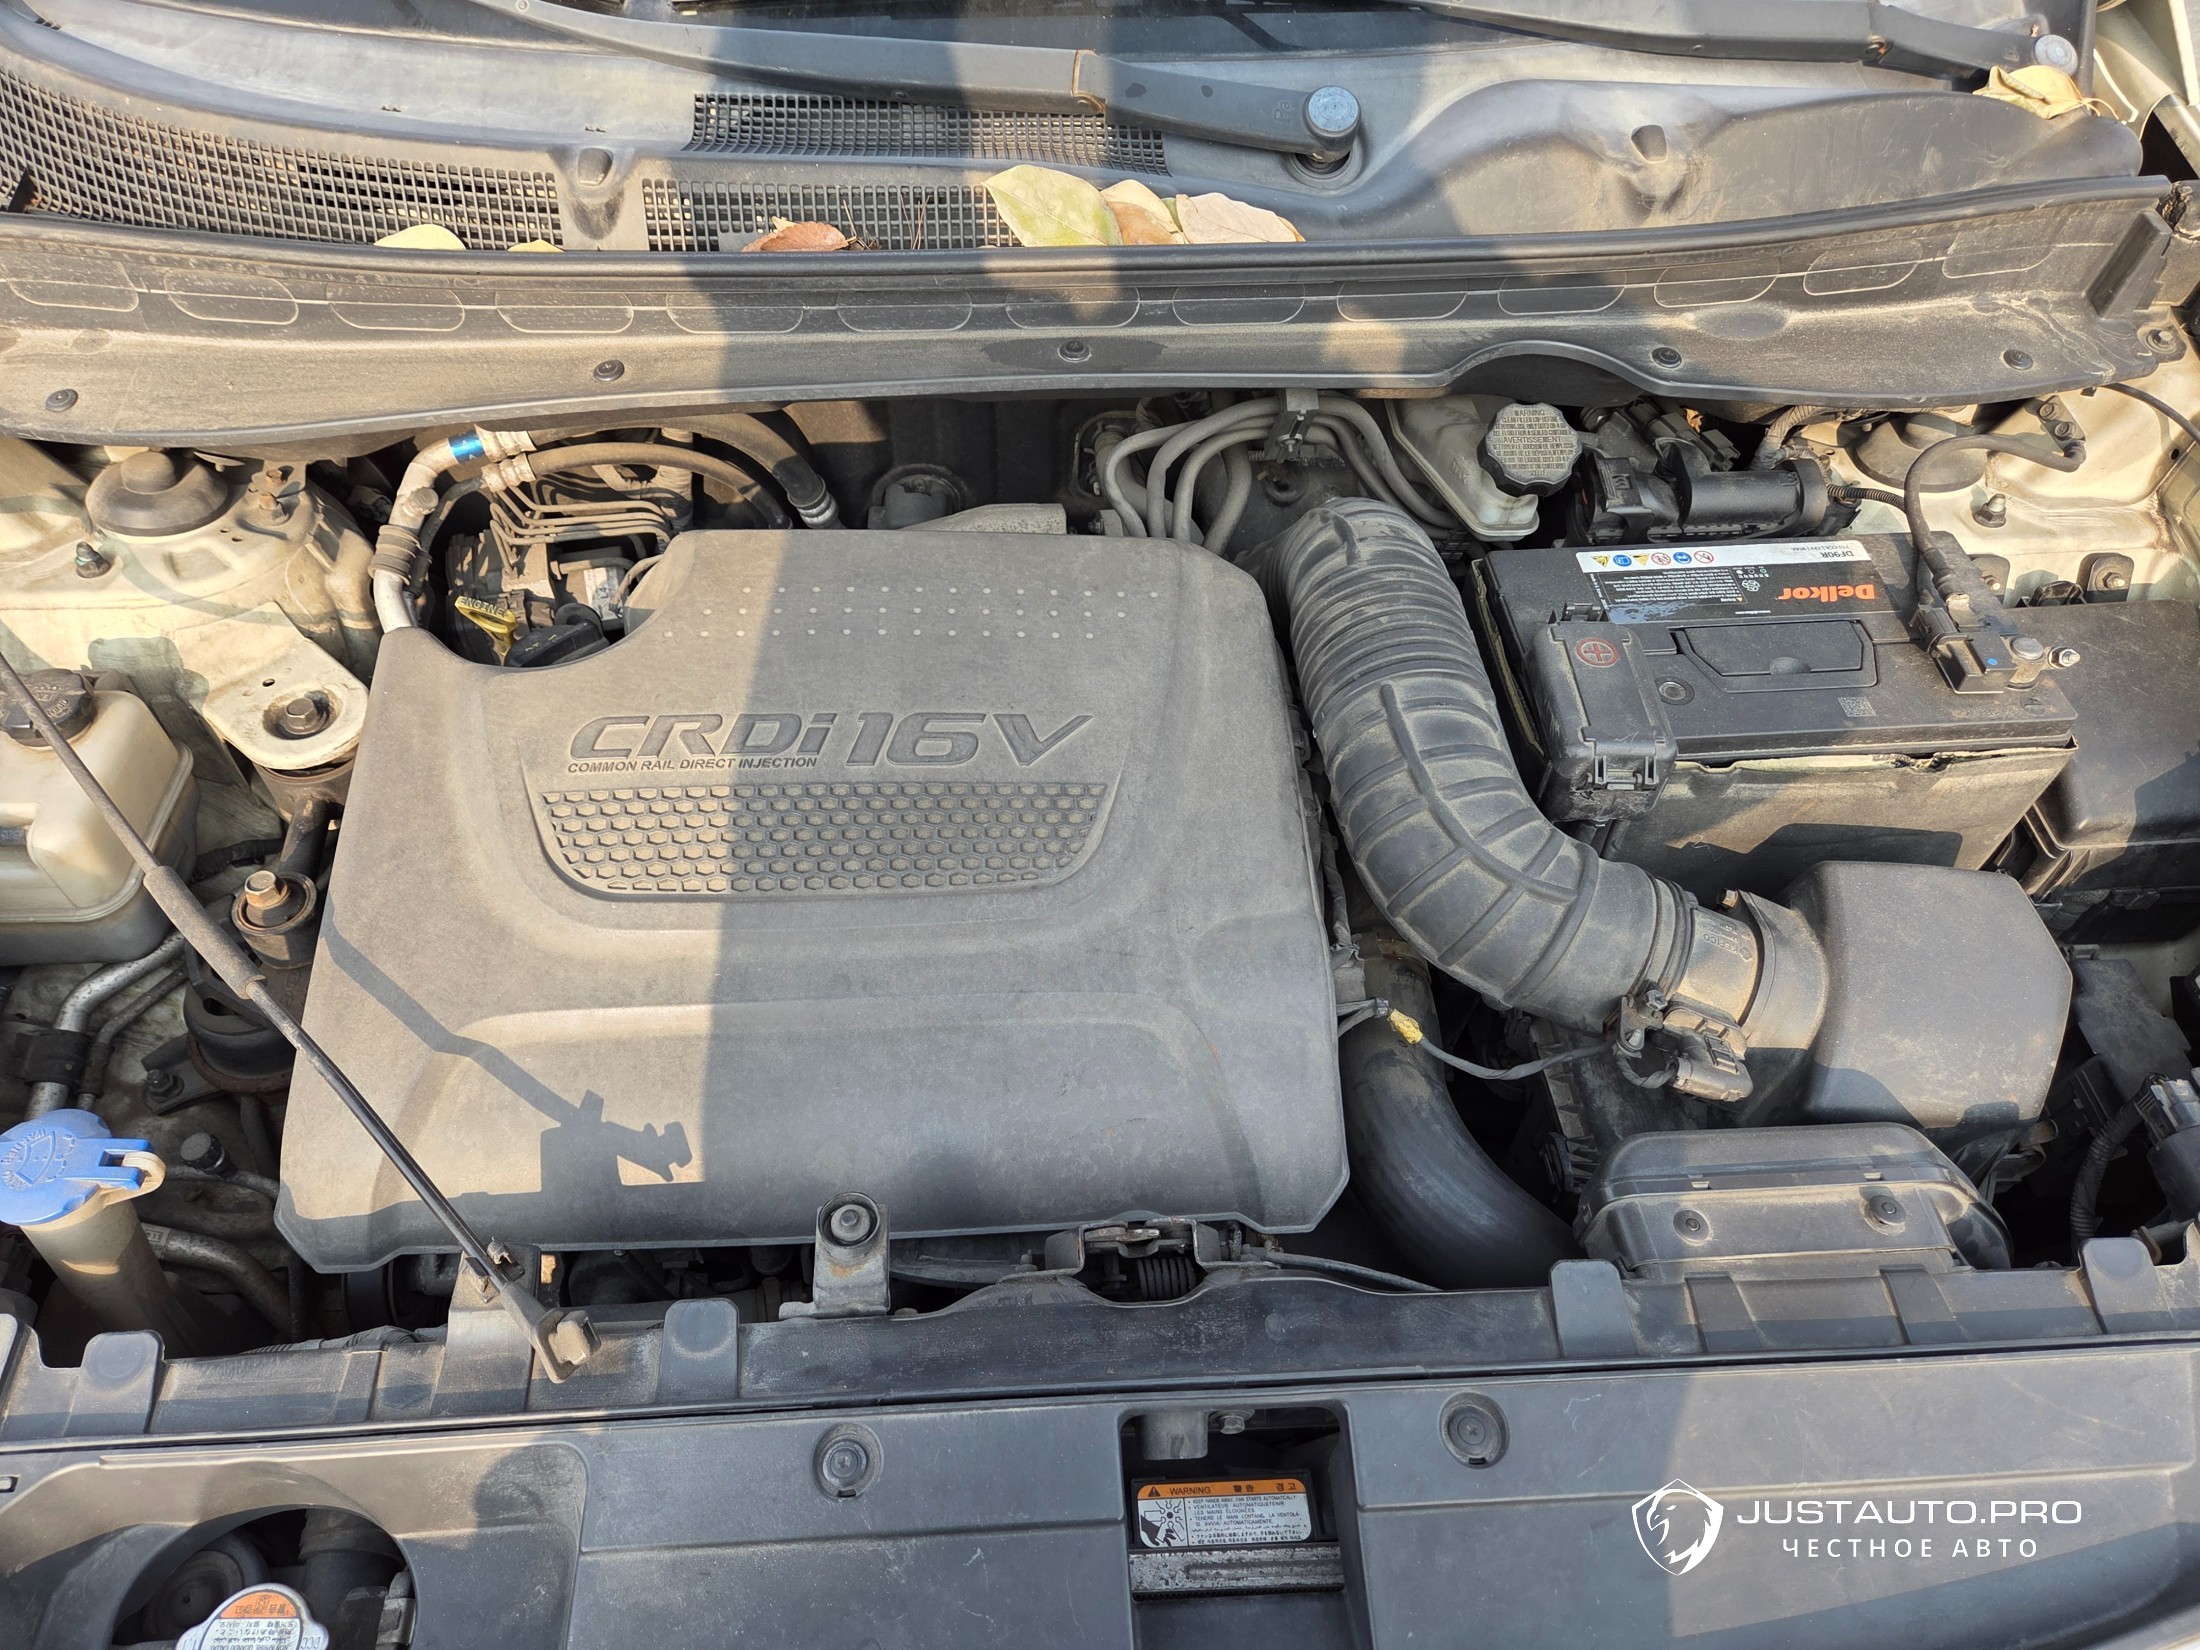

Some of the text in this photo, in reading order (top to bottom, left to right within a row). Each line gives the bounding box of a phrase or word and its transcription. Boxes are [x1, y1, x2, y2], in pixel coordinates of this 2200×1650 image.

[1514, 409, 1546, 417] WARNING
[1821, 550, 1854, 559] DF90R
[1778, 584, 1876, 603] Delkor
[458, 596, 507, 616] ENGINE
[569, 711, 1094, 766] CRDi 16V
[568, 756, 818, 773] COMMON RAIL DIRECT INJECTION
[1703, 933, 1738, 954] KEFICO
[1169, 1486, 1211, 1495] WARNING
[1276, 1482, 1296, 1491] 경고
